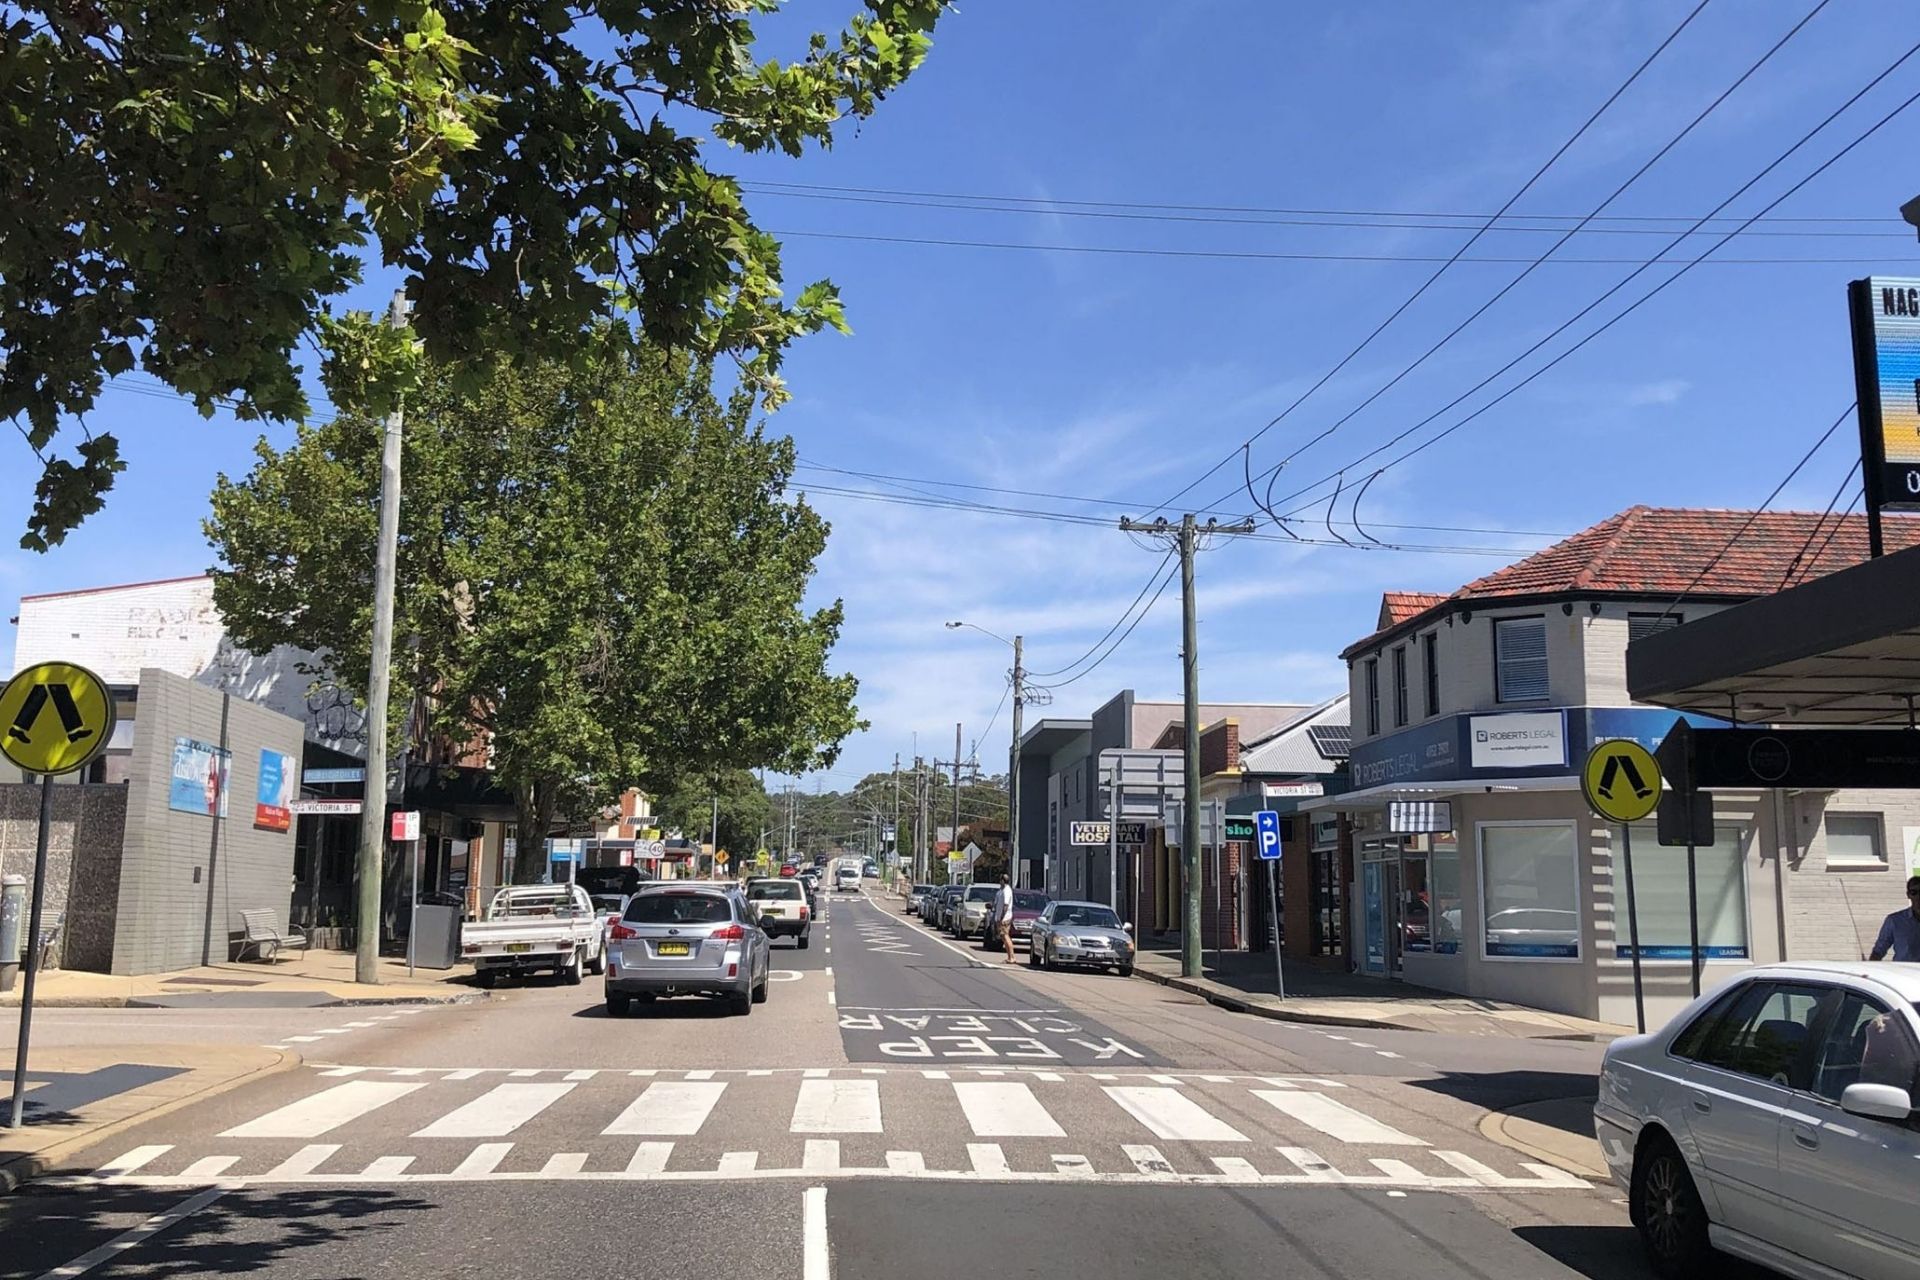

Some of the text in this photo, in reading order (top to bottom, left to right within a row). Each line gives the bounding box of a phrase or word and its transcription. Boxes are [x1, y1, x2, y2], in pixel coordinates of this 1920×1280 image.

[1490, 730, 1557, 741] ROBERTS LEGAL
[1363, 759, 1395, 784] ROBERTS
[1395, 753, 1418, 776] LEGAL
[308, 803, 340, 812] VICTORIA
[344, 803, 353, 812] ST
[1075, 824, 1141, 833] VETERARY
[1075, 832, 1141, 842] HOSPTAL
[1262, 831, 1277, 854] P
[838, 1014, 1083, 1034] CLEAR
[878, 1035, 1145, 1060] KEEP
